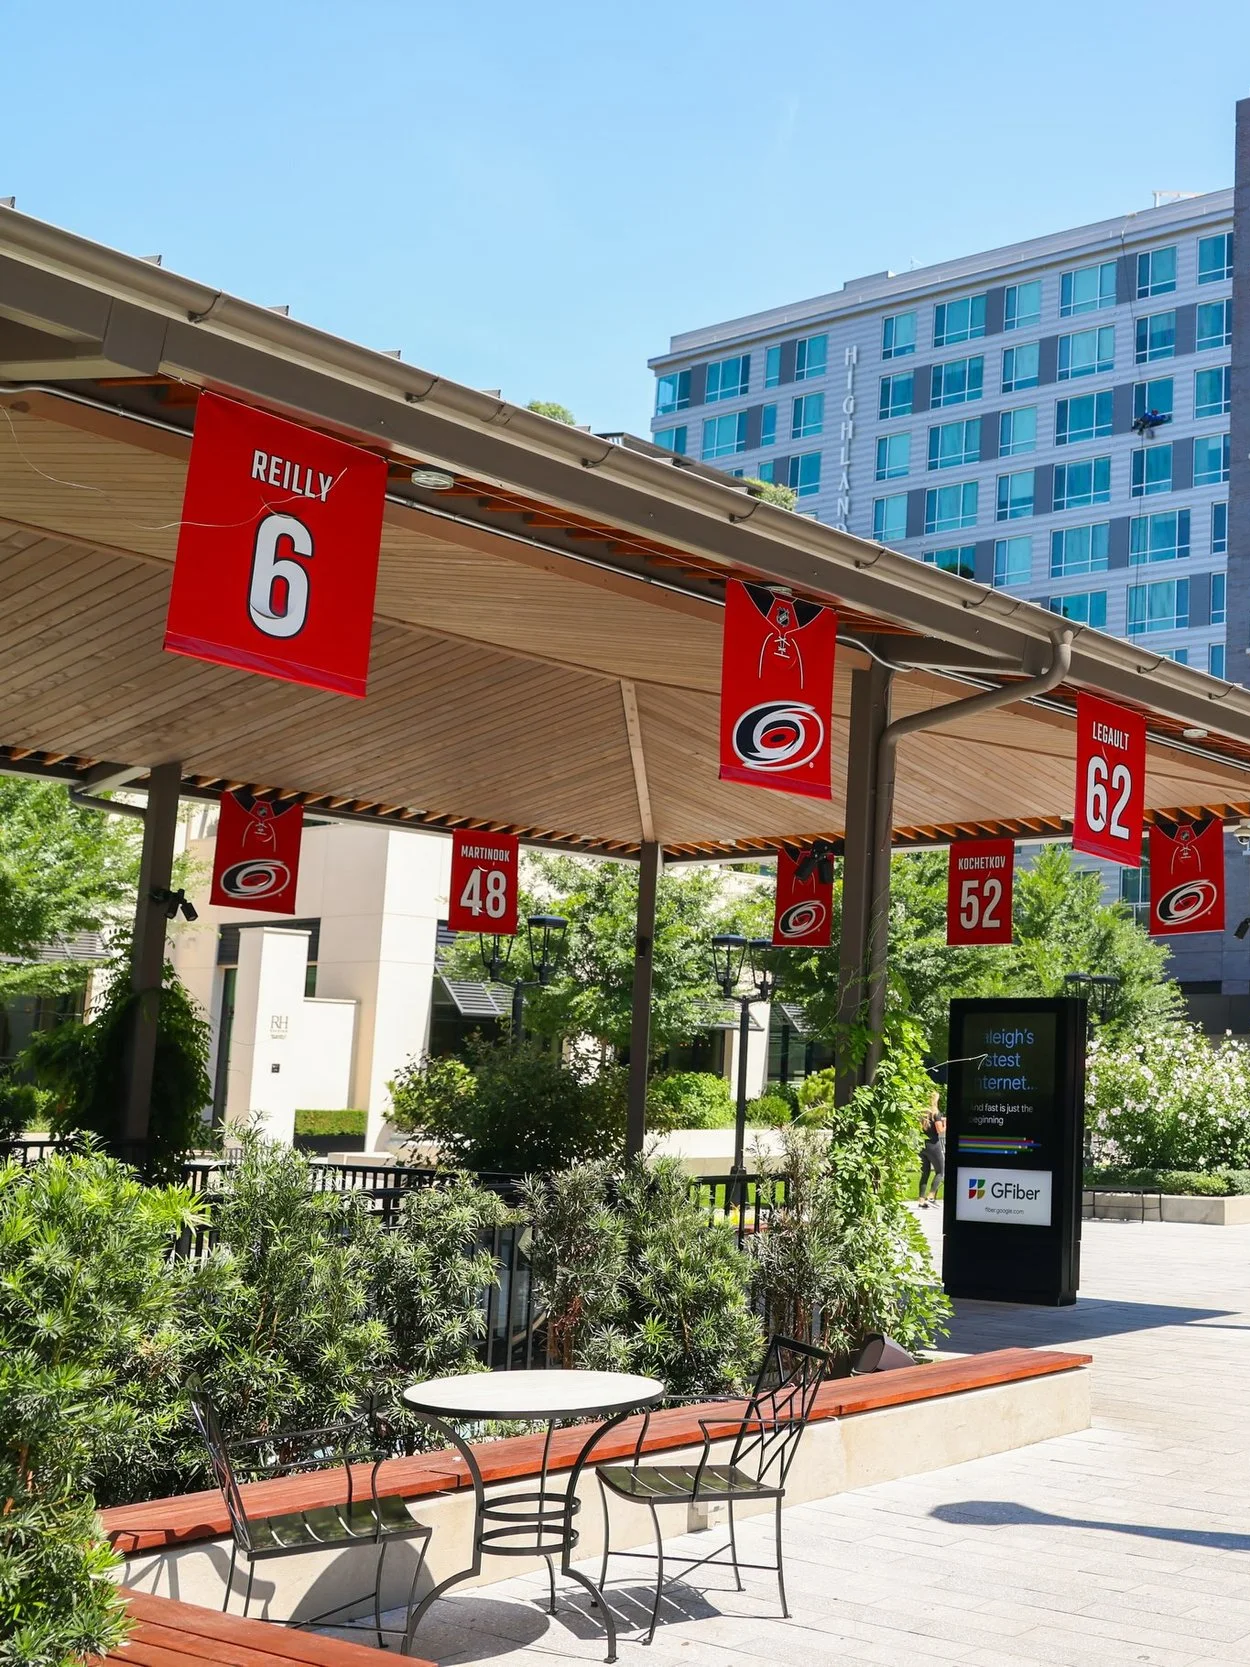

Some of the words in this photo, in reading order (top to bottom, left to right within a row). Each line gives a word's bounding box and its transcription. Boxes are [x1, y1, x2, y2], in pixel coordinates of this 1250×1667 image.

[251, 449, 333, 502] REILLY
[248, 512, 314, 639] 6
[1092, 721, 1130, 751] LEGAULT
[1086, 755, 1132, 840] 62
[461, 845, 510, 862] MARTINOOK
[958, 856, 1006, 870] KOCHETKOV
[460, 868, 507, 918] 48
[960, 878, 1002, 929] 52
[271, 1015, 288, 1029] RH
[984, 1028, 1034, 1049] leigh's
[984, 1052, 1021, 1067] stest
[985, 1103, 998, 1112] fast
[1000, 1104, 1006, 1112] is
[1006, 1104, 1020, 1114] just
[1021, 1104, 1033, 1113] the
[991, 1182, 1040, 1200] GFiber
